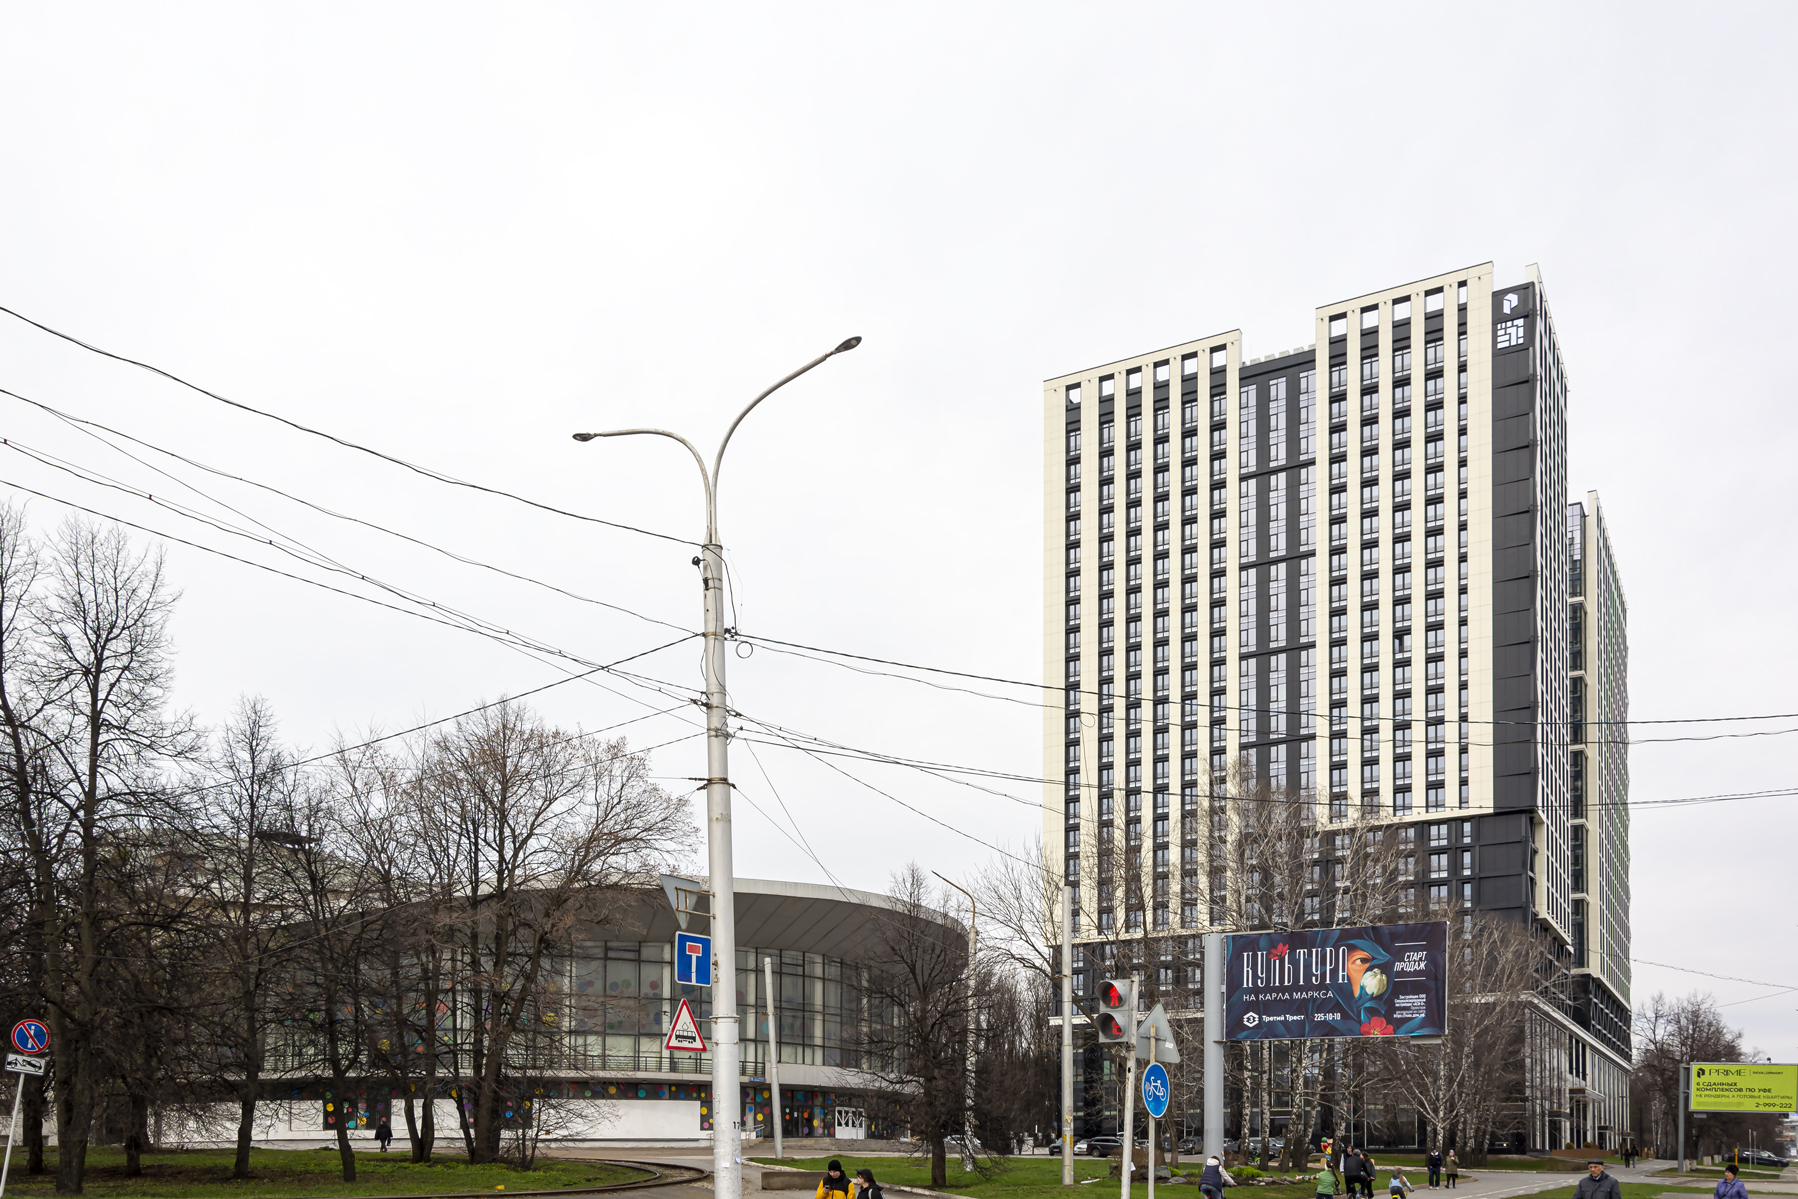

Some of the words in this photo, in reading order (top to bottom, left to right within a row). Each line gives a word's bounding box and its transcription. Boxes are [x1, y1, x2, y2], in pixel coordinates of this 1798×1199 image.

[1404, 951, 1427, 962] СТАРТ
[1242, 946, 1349, 988] КУЛЬТУРА
[1394, 961, 1427, 972] ПРОДАЖ
[1243, 993, 1256, 1002] НА
[1259, 992, 1290, 1001] КАРЛА
[1292, 990, 1334, 1000] МАРКСА
[1285, 1014, 1305, 1022] Трест
[1314, 1012, 1341, 1021] 225-10-10
[1709, 1068, 1747, 1077] PRIME
